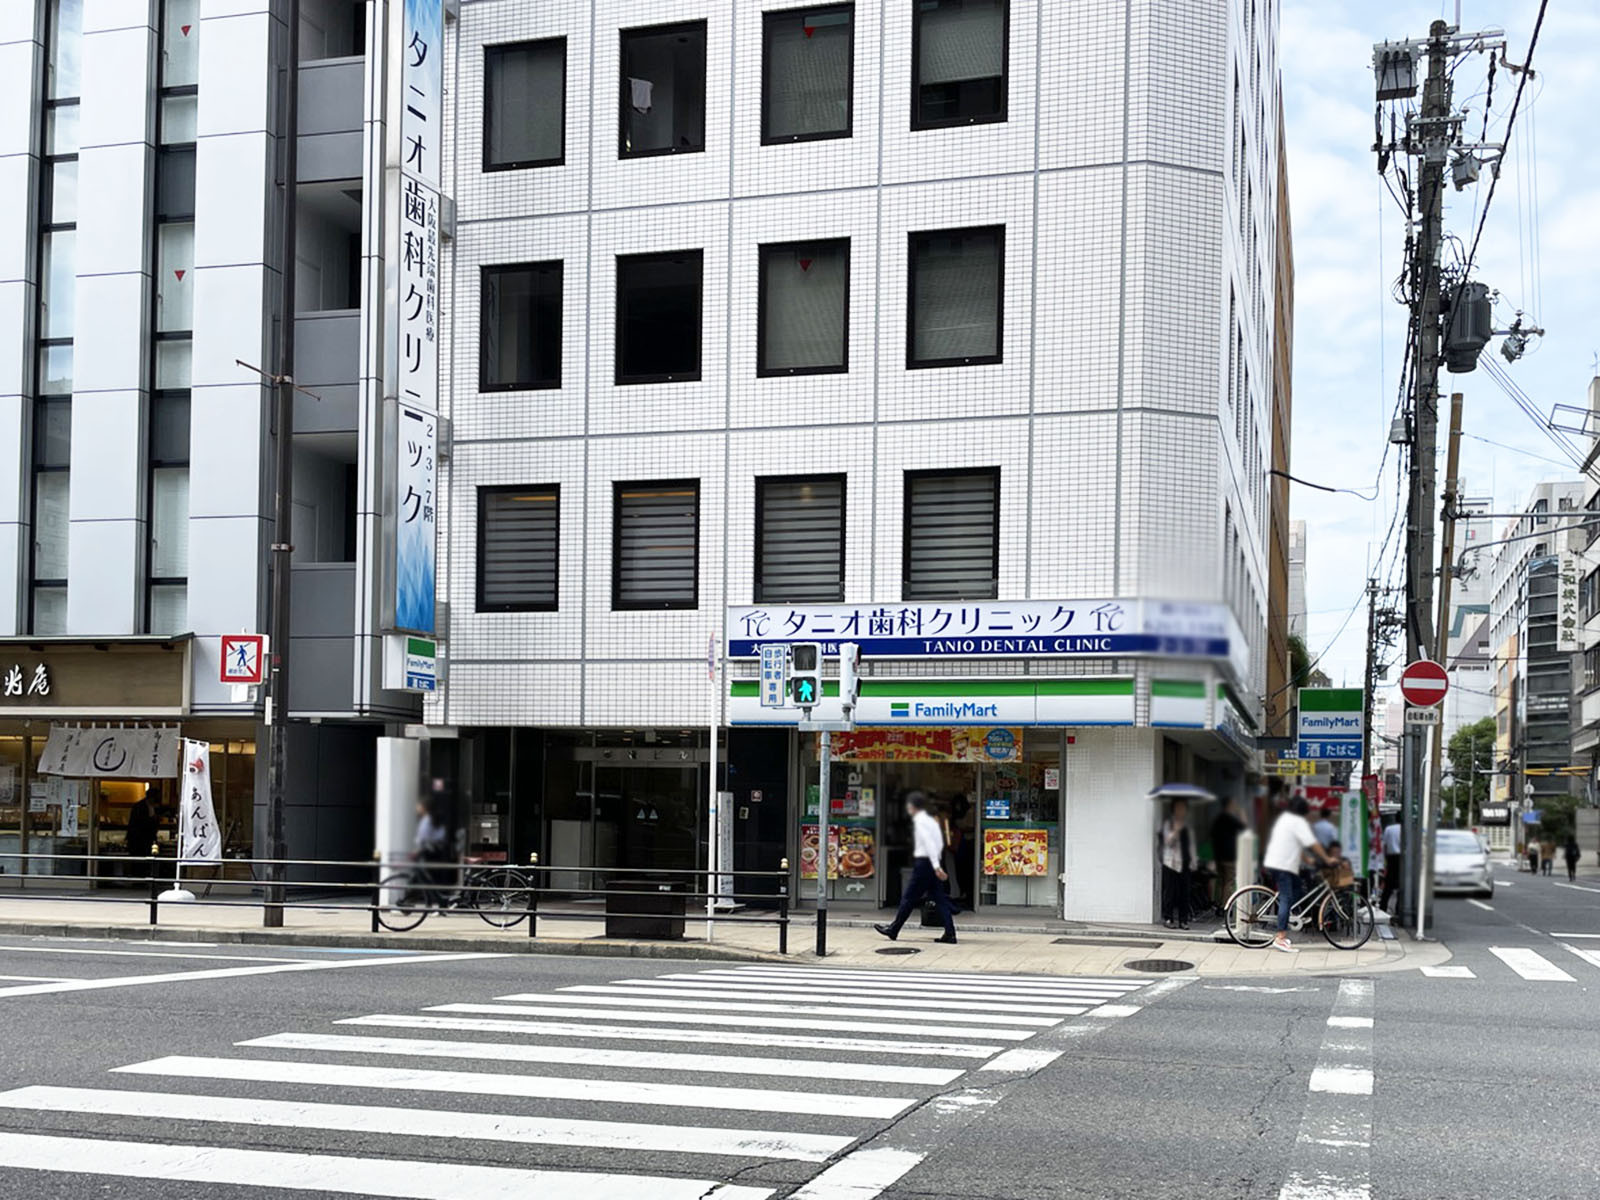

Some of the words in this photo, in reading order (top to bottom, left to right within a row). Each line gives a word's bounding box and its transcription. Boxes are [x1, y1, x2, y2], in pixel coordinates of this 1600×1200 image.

[402, 30, 428, 524] タニオ歯科クリニック
[1561, 559, 1577, 642] 三和株式会社
[783, 605, 1076, 637] タニオ歯科クリニック
[923, 640, 975, 653] TANIO
[981, 639, 1047, 652] DENTAL
[1054, 638, 1111, 651] CLINIC
[915, 703, 998, 719] FamilyMart
[1301, 716, 1360, 731] FamilyMart
[1305, 742, 1321, 758] 酒
[1326, 744, 1357, 757] たばこ
